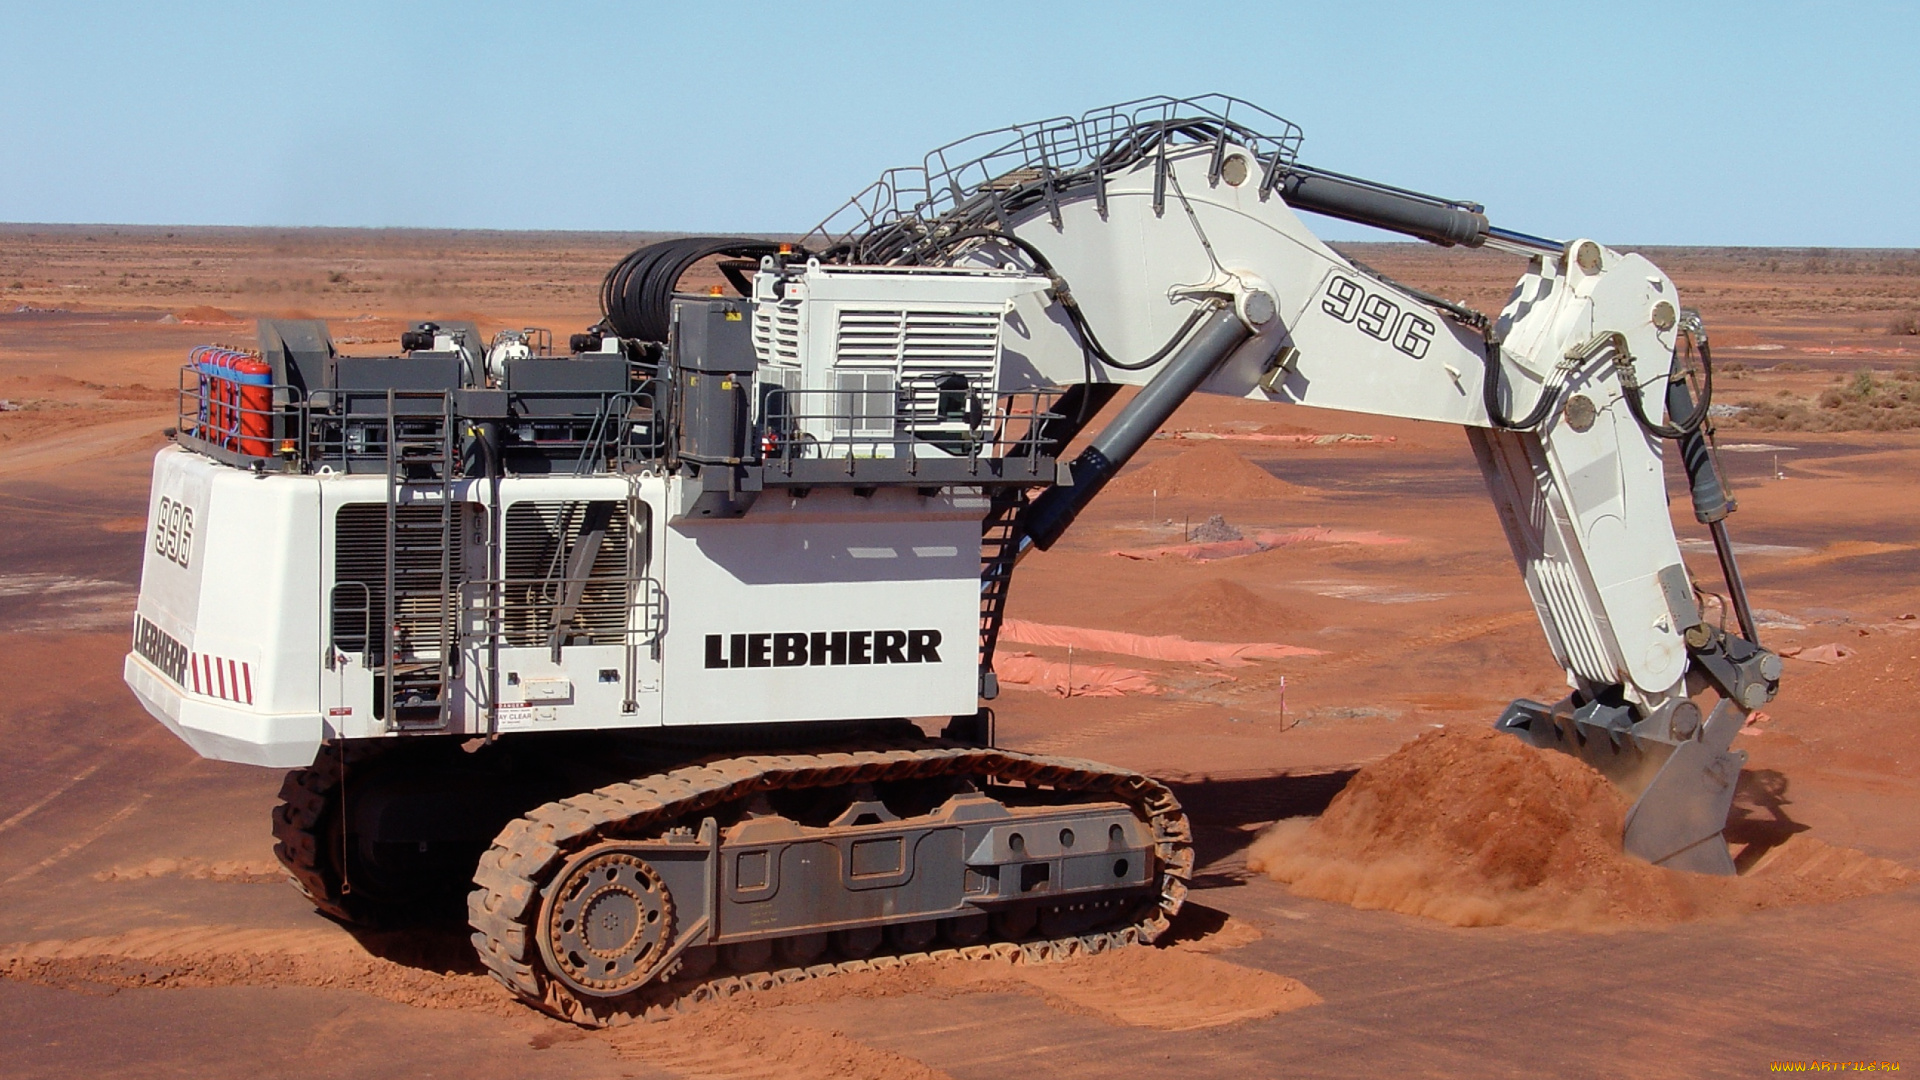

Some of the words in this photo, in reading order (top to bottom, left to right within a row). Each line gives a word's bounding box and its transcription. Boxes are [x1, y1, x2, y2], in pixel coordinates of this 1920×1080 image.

[1321, 275, 1436, 360] 996
[156, 495, 195, 569] 996
[134, 613, 188, 689] LIEBHERR
[704, 629, 943, 669] LIEBHERR
